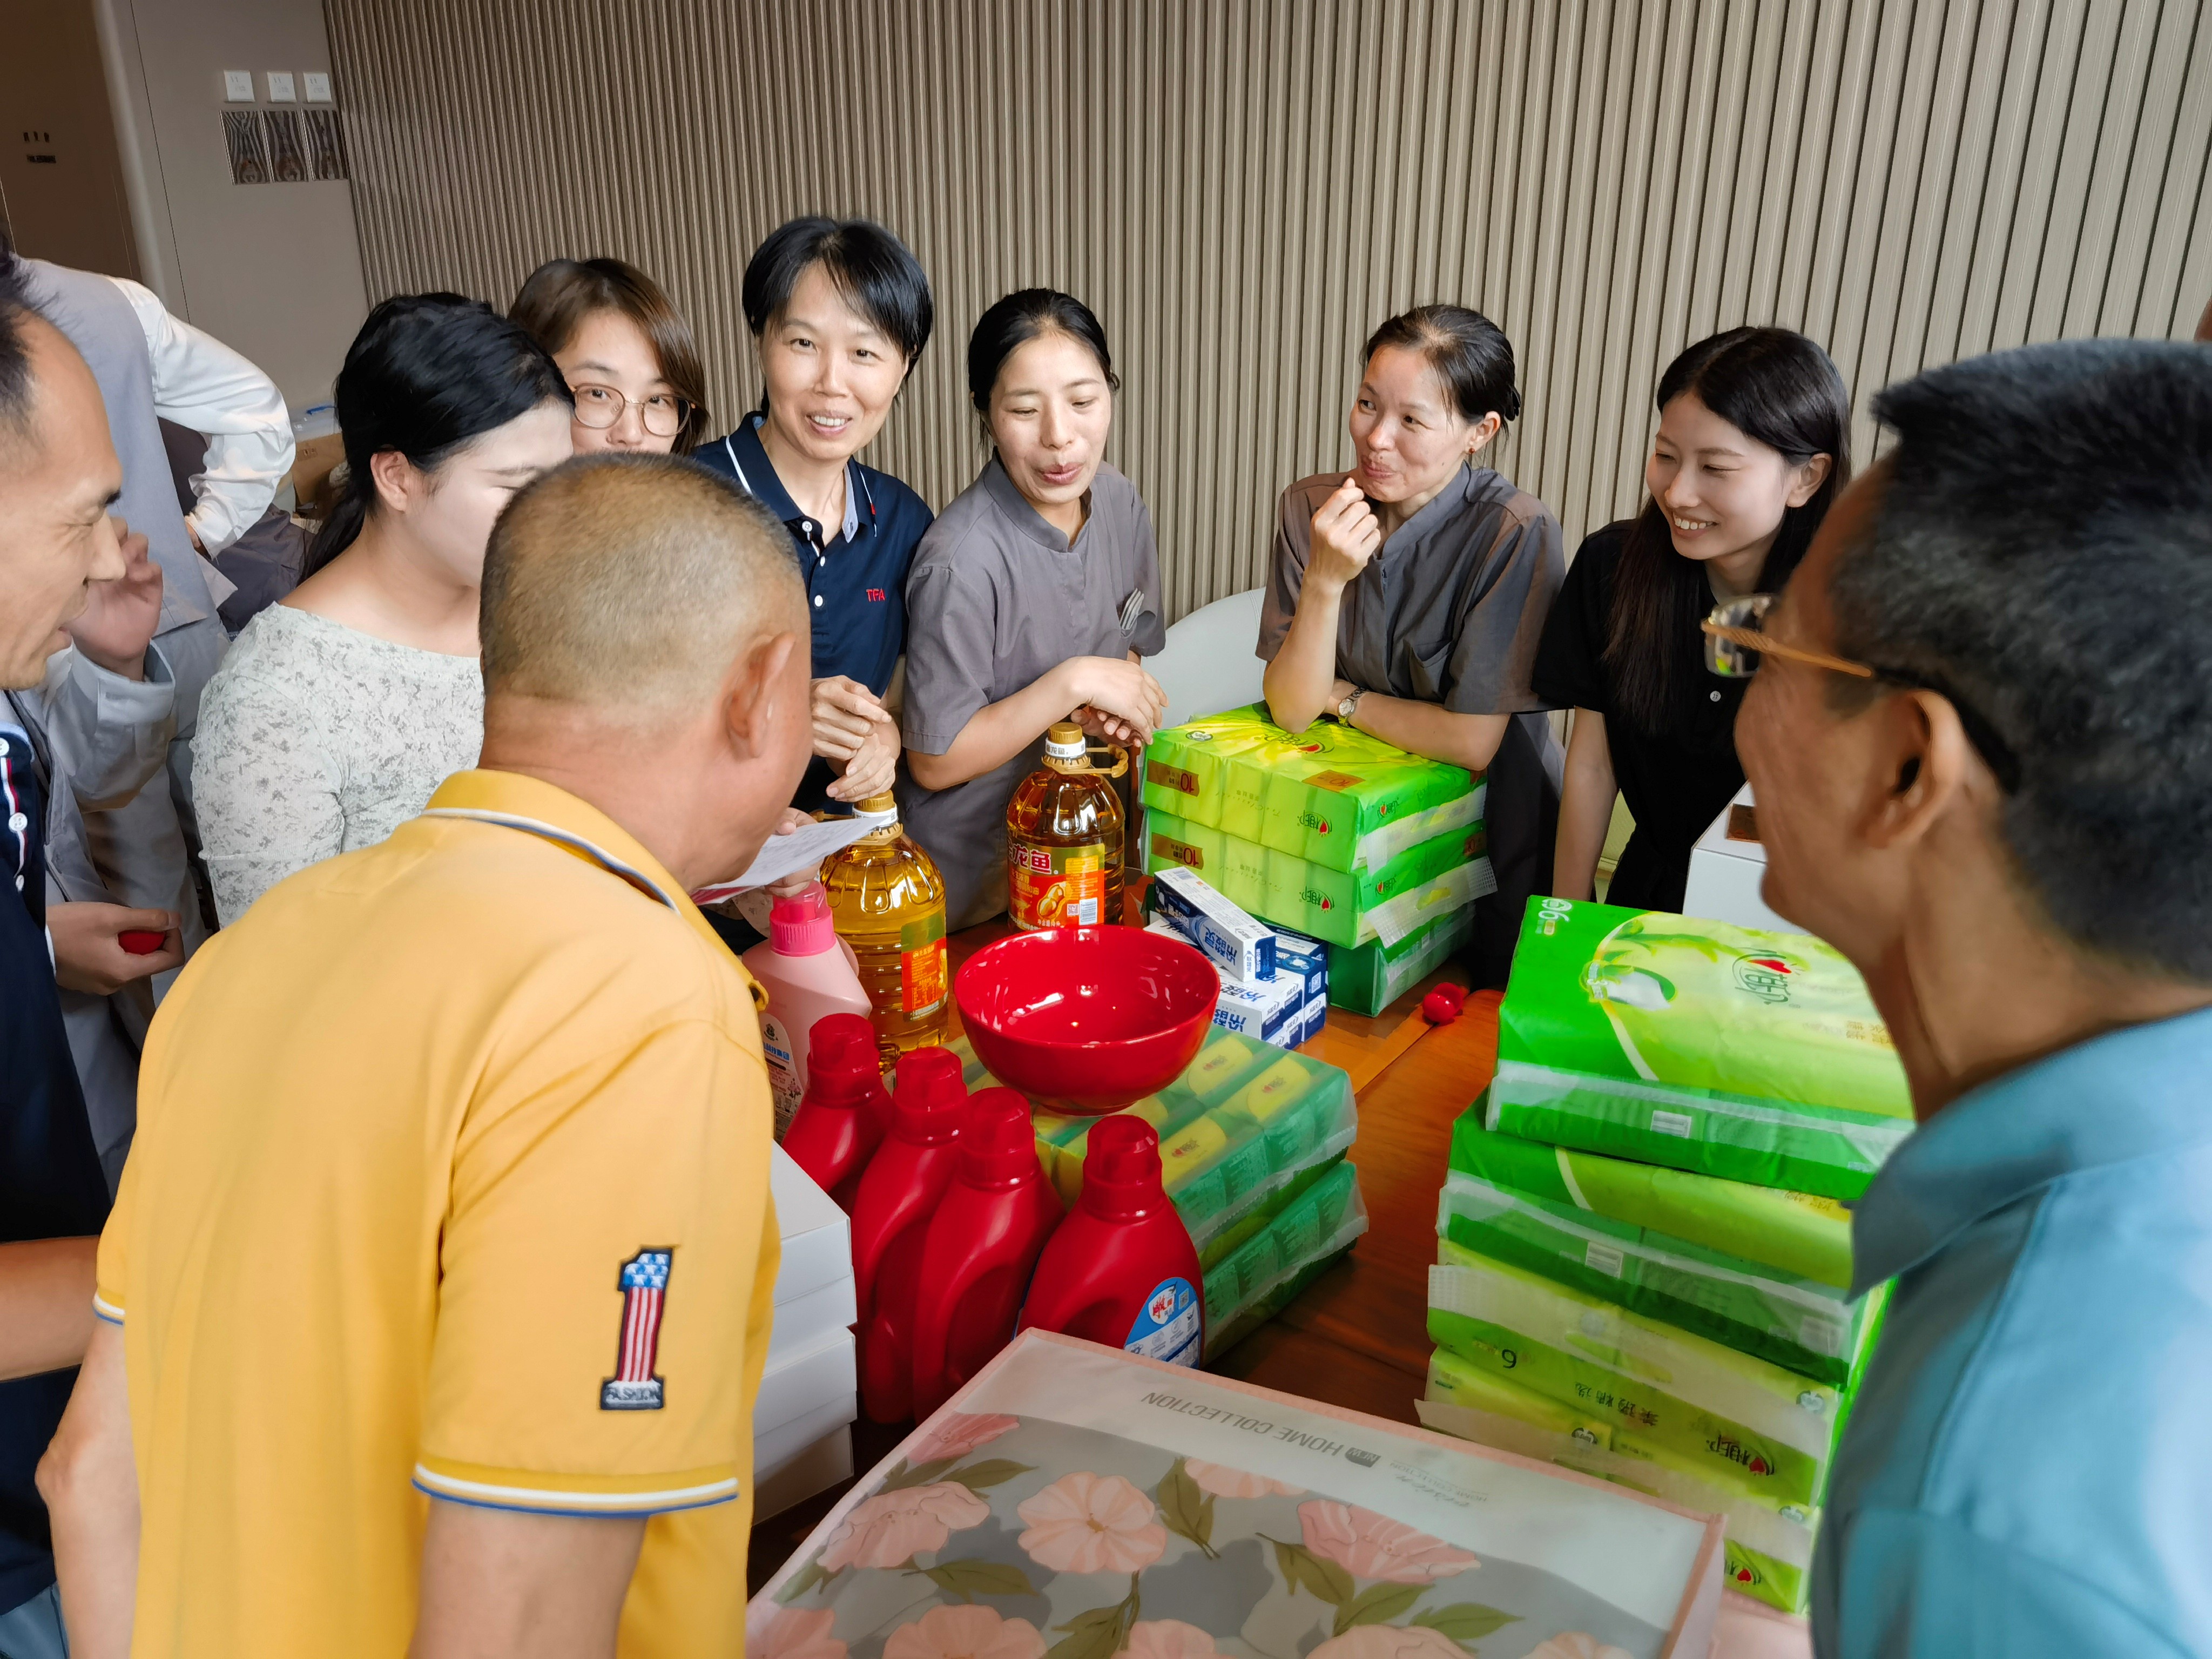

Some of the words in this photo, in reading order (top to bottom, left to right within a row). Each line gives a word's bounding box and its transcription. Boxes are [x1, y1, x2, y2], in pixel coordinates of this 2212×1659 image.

[866, 588, 886, 602] TFA
[1180, 773, 1195, 793] 10
[1297, 810, 1332, 837] 心相印
[1183, 847, 1199, 866] 10
[1299, 886, 1334, 913] 心相印
[1203, 924, 1238, 966] 冷酸灵
[1501, 1348, 1516, 1368] 6
[1141, 1392, 1274, 1434] COLLECTION
[1273, 1427, 1344, 1456] HOME
[1351, 1448, 1380, 1463] NEW
